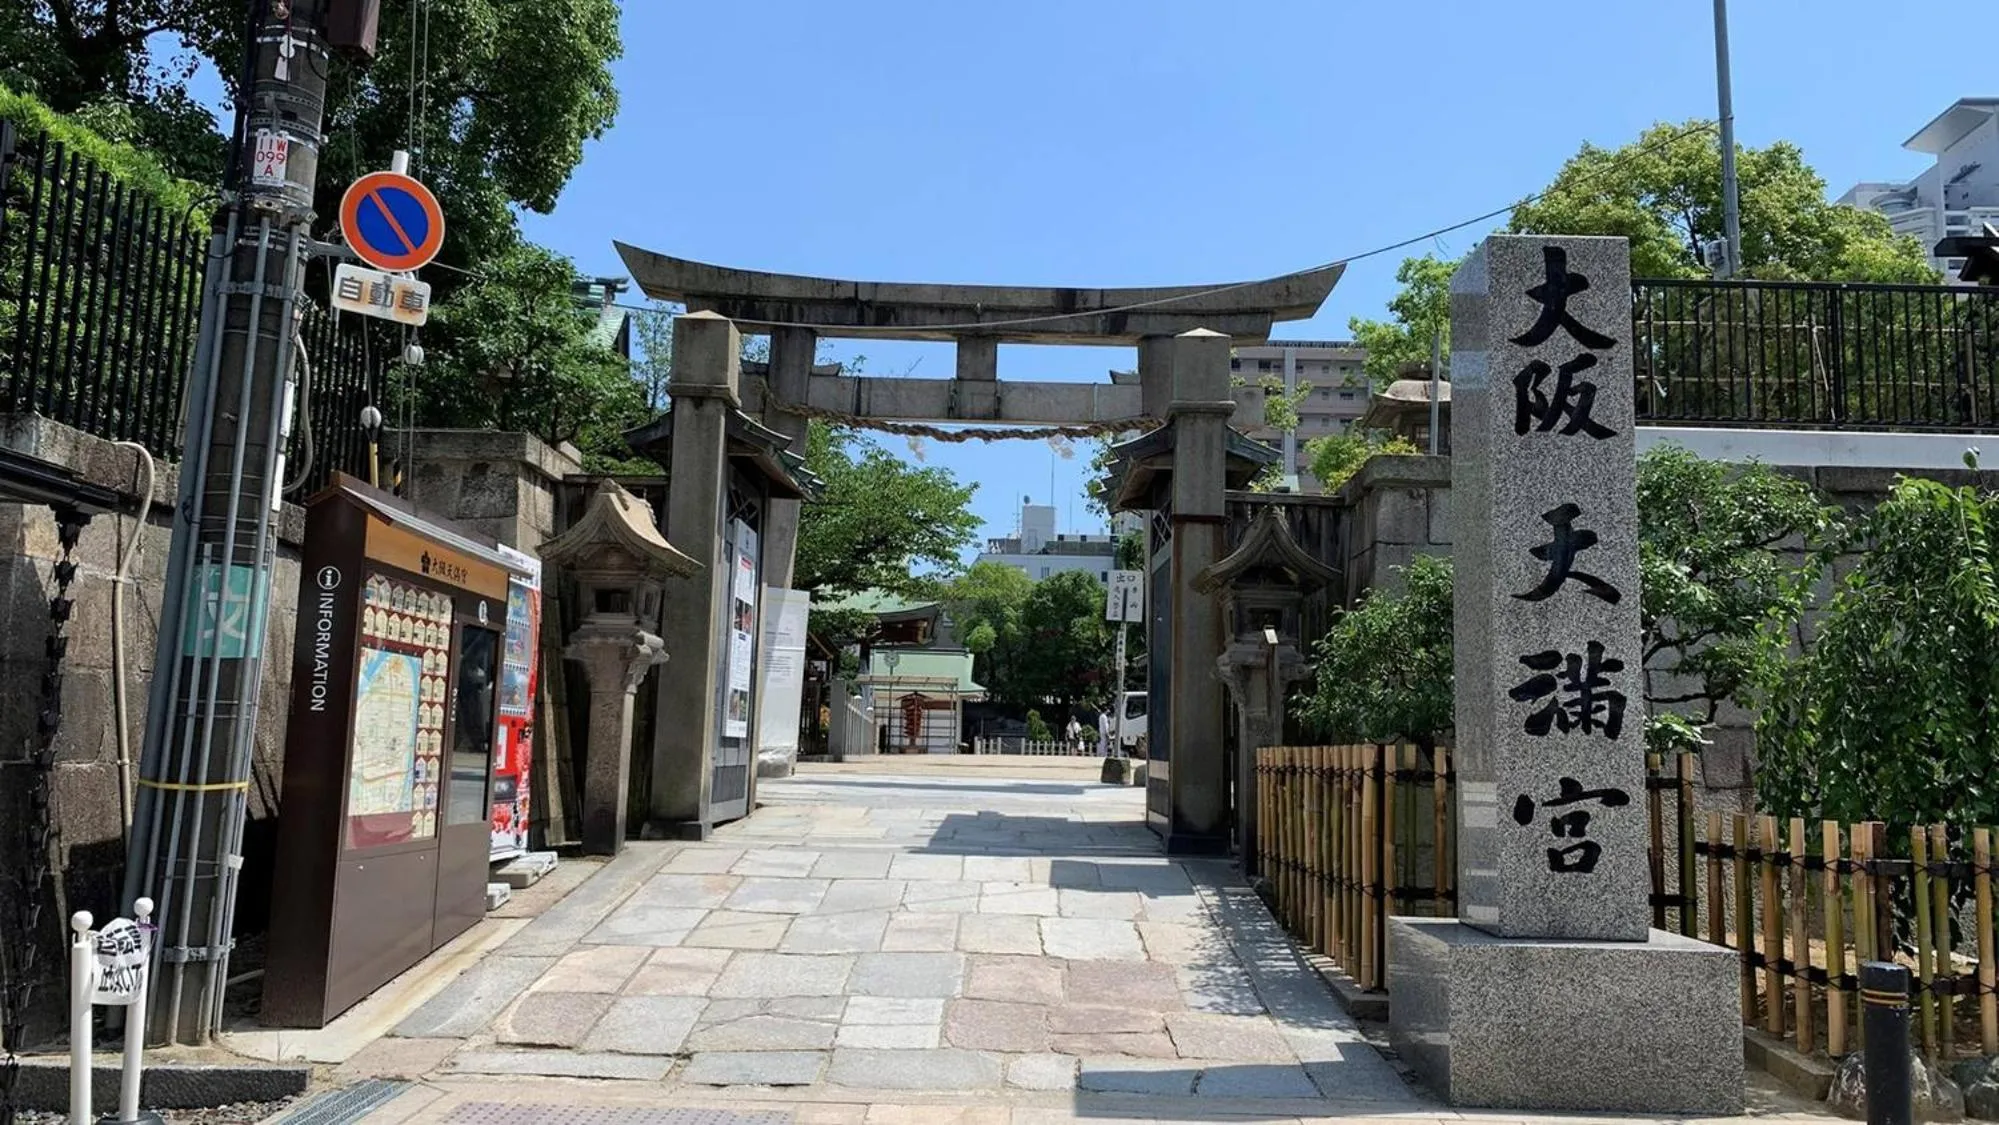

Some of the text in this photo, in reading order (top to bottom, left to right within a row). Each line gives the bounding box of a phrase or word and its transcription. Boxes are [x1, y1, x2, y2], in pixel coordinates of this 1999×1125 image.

[256, 152, 286, 164] 099
[264, 164, 273, 176] A
[338, 275, 425, 314] 自動車
[1508, 245, 1630, 874] 大阪天満宮
[310, 593, 334, 711] INFORMATION
